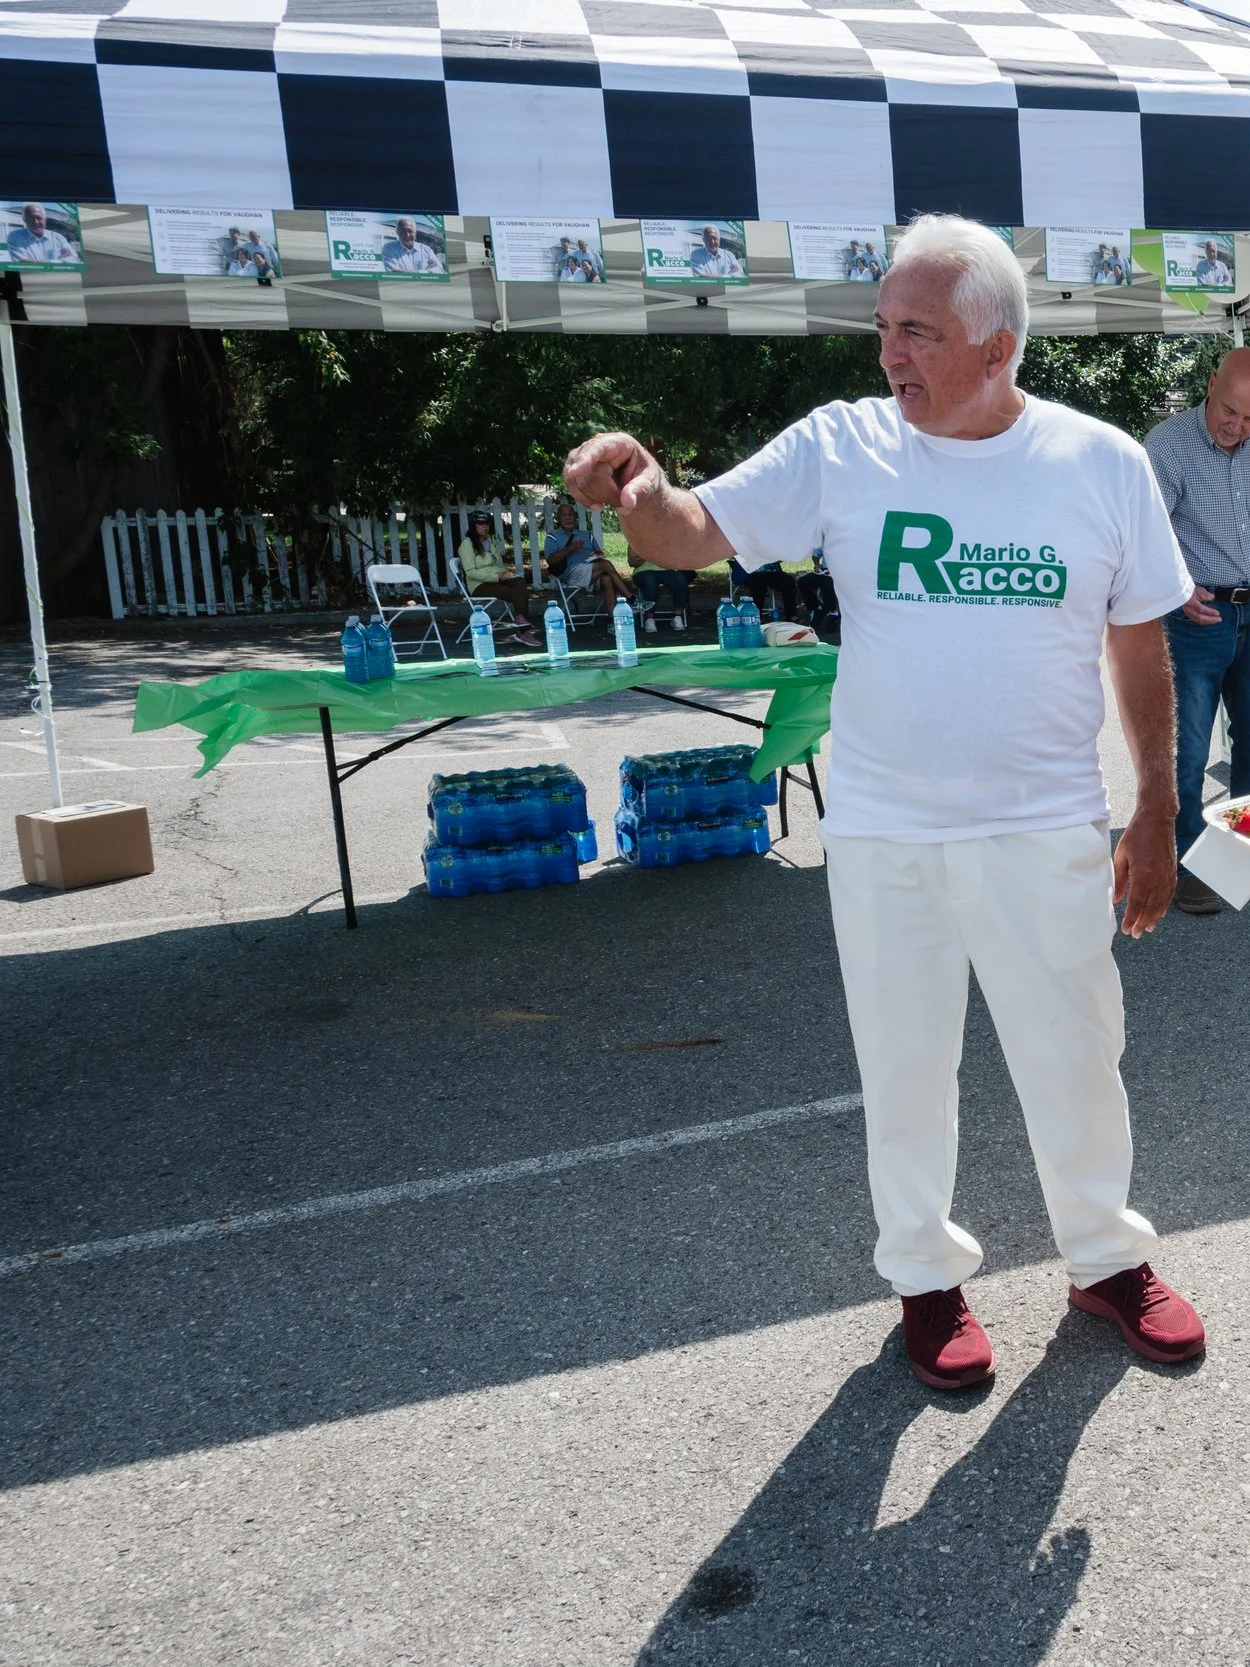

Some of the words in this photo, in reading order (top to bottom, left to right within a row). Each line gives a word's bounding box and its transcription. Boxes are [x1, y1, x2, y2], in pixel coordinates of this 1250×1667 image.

[877, 510, 1061, 595] Racco
[959, 542, 1030, 562] Mario
[1039, 545, 1064, 565] G.
[877, 591, 927, 602] RELIABLE.
[928, 595, 1000, 606] RESPONSIBLE.
[1001, 597, 1063, 609] RESPONSIVE.
